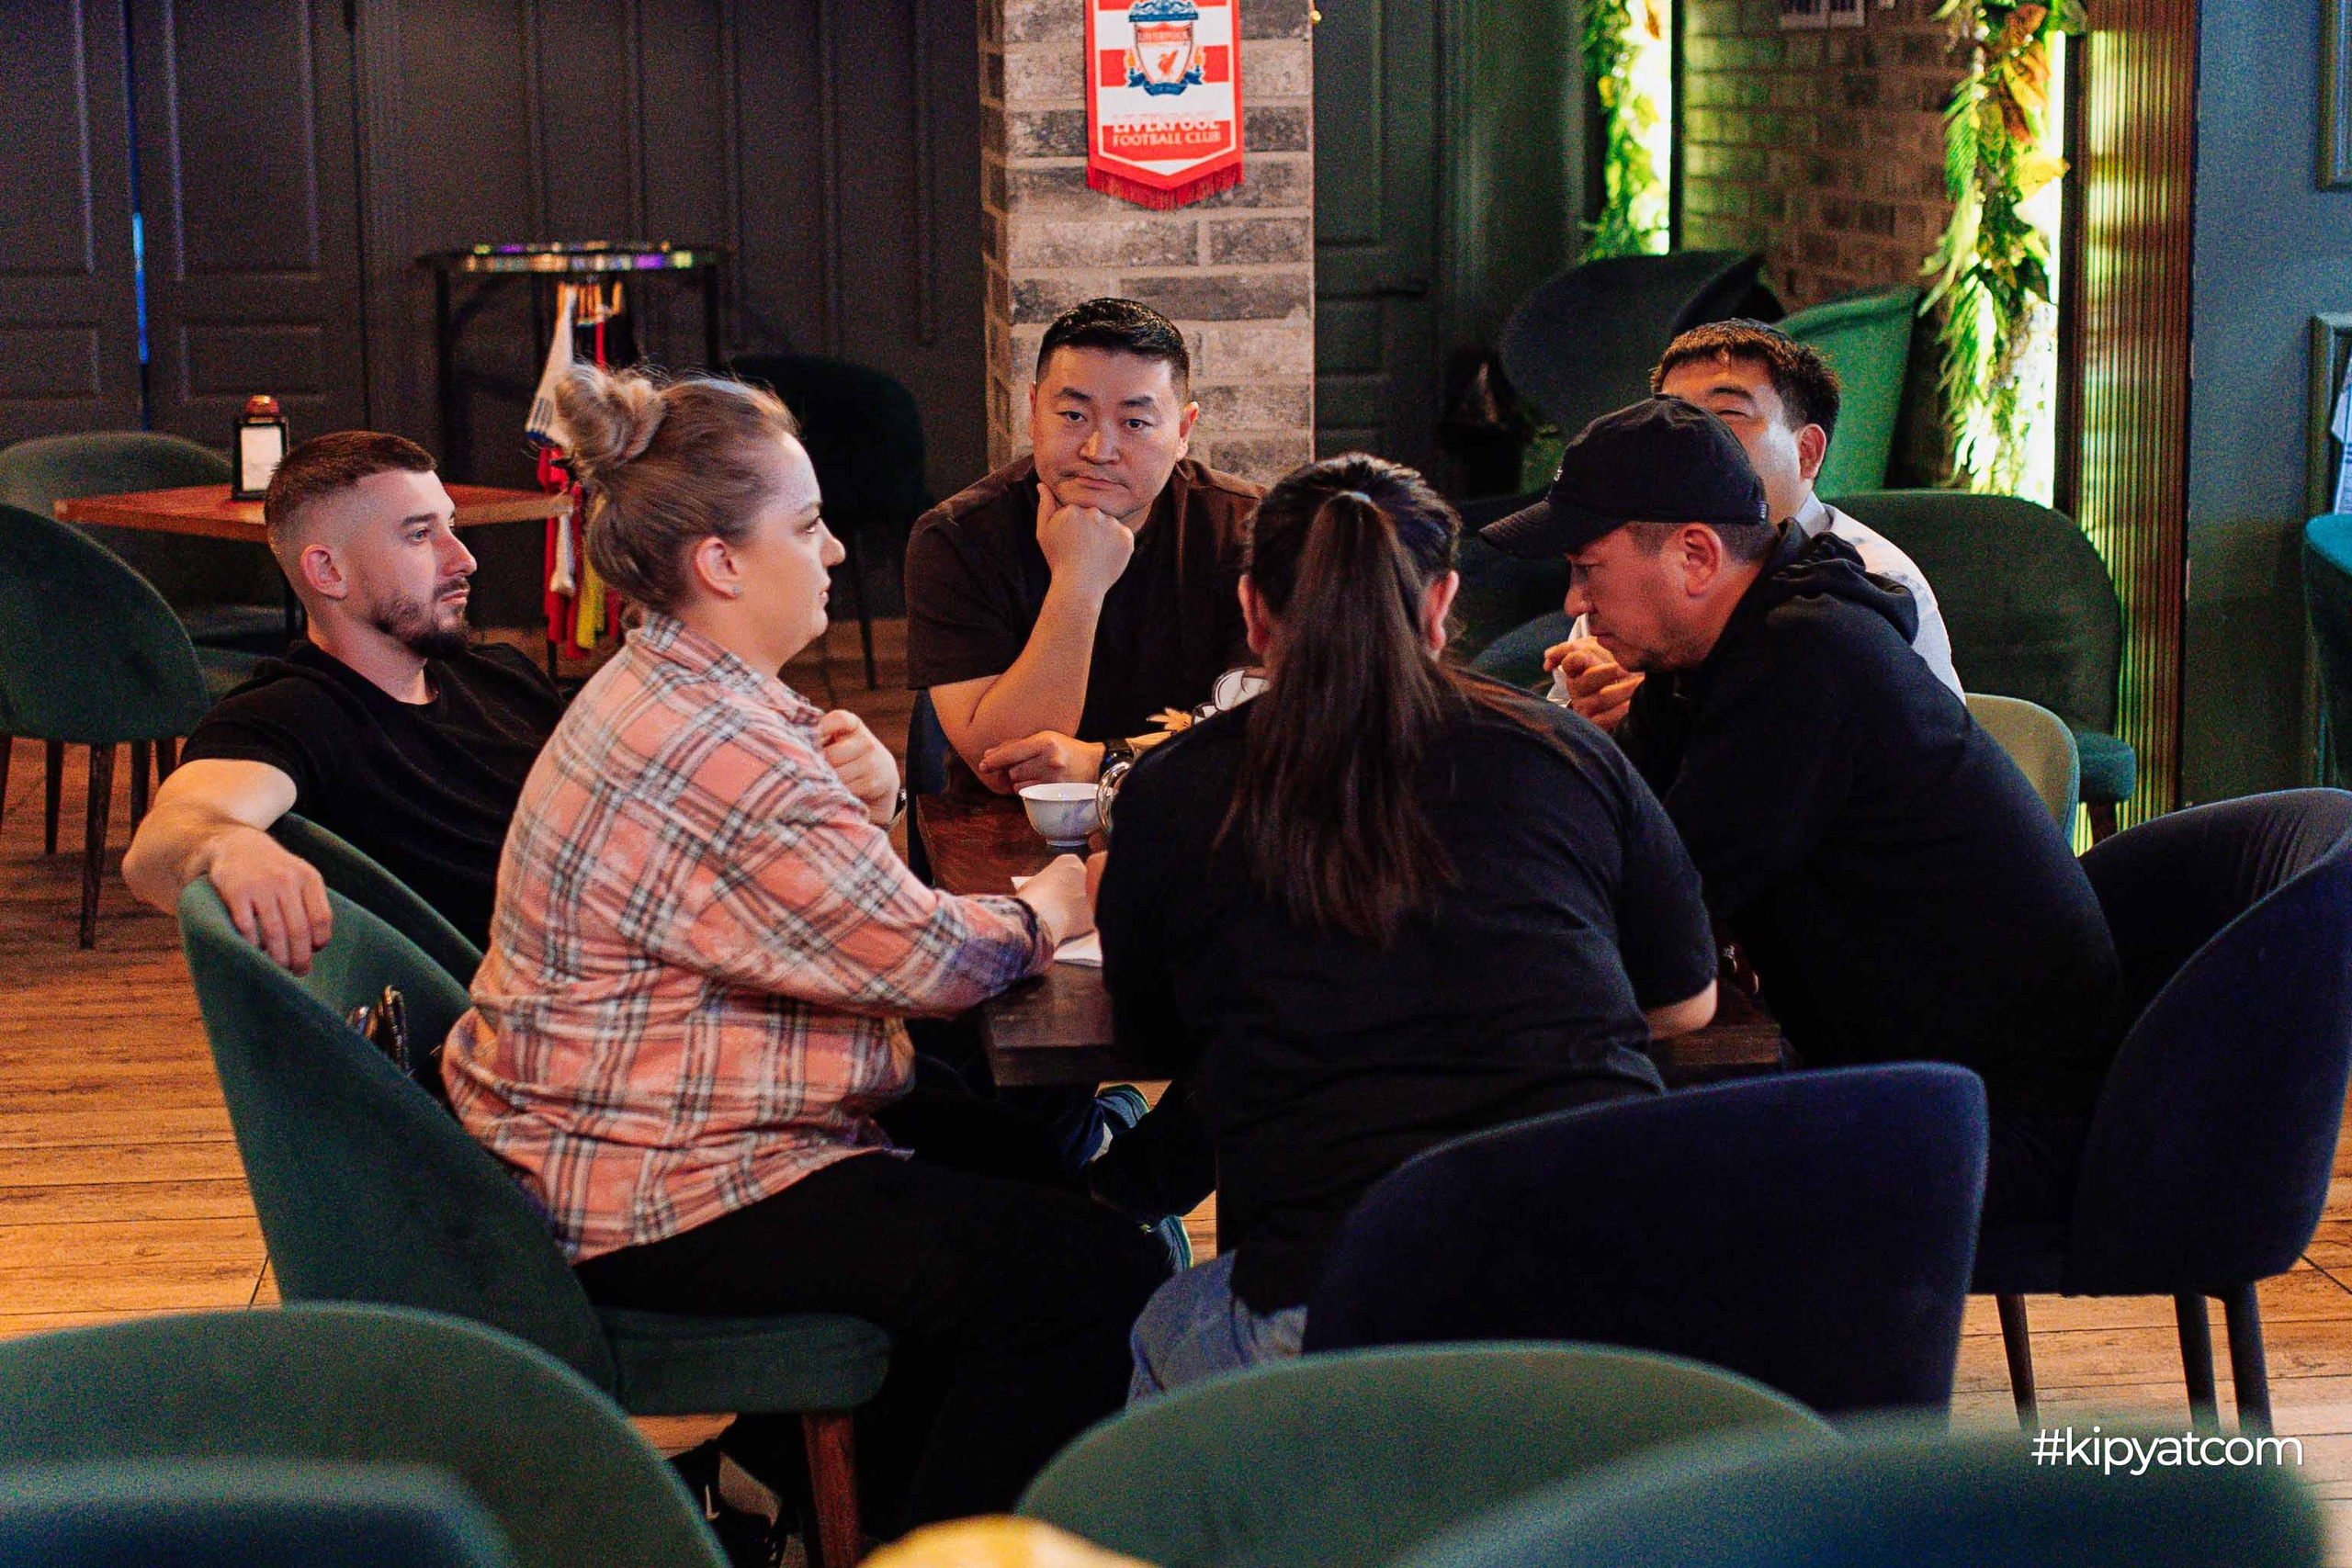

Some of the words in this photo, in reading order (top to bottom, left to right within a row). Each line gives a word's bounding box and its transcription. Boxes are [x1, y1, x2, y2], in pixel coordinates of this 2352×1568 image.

[1113, 113, 1220, 132] LIVERPOOL
[1113, 133, 1182, 147] FOOTBALL
[1184, 130, 1221, 144] CLUB
